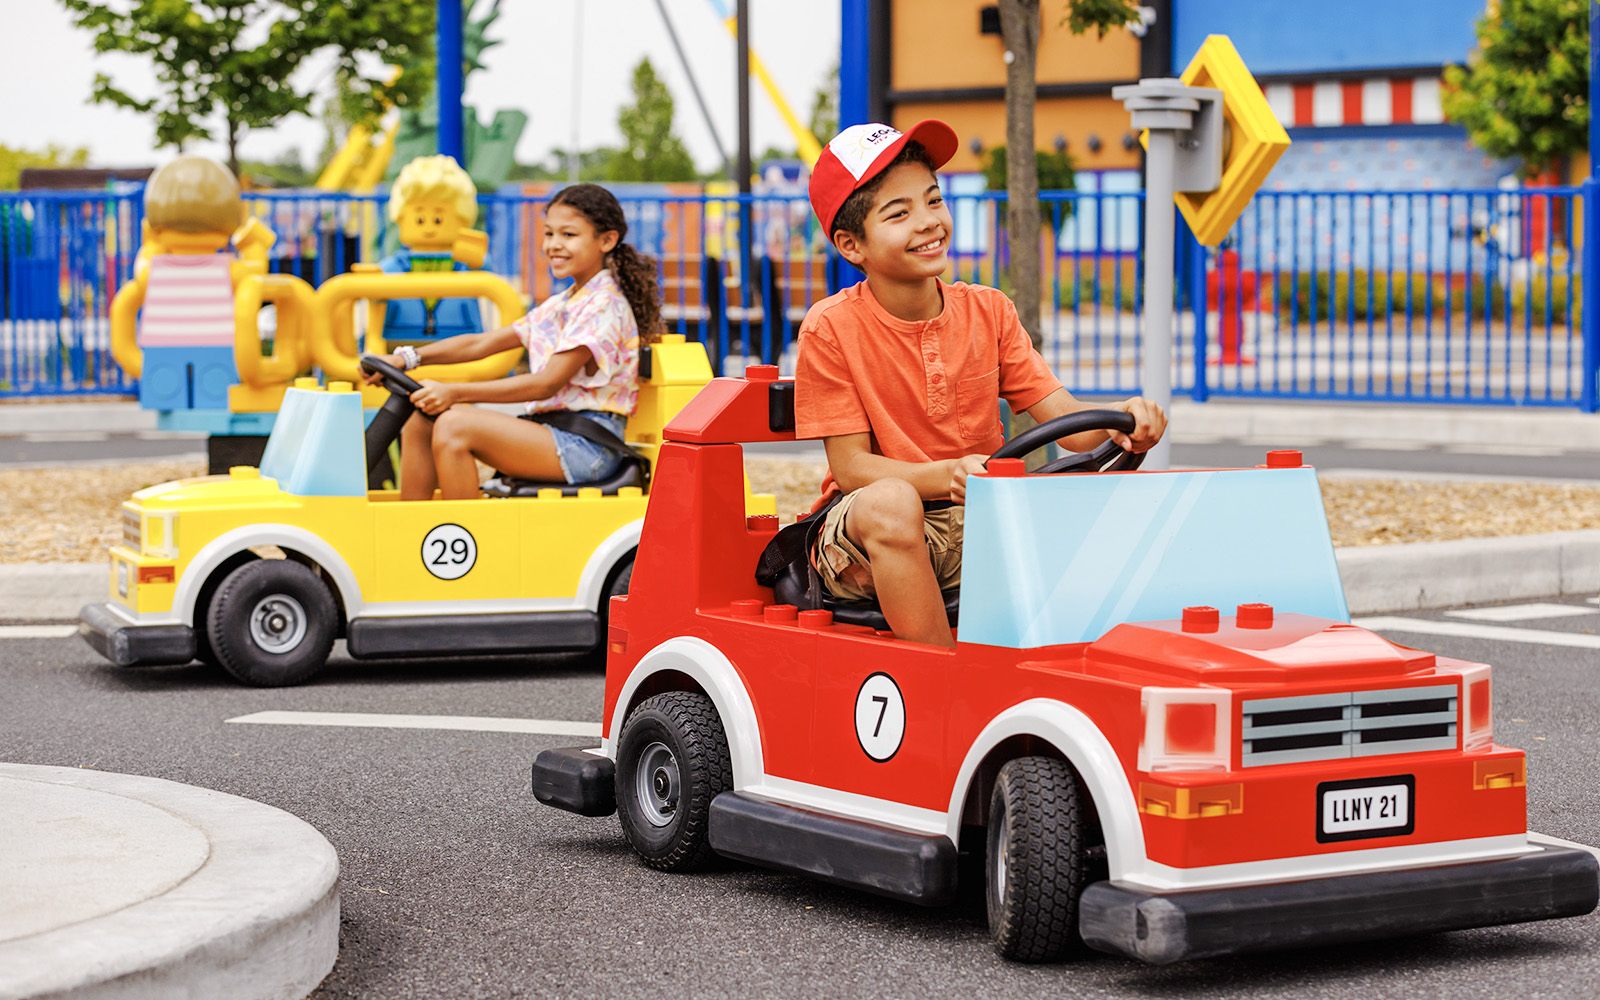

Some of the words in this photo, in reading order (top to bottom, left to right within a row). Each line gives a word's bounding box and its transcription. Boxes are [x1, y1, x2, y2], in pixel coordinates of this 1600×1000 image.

[431, 538, 468, 564] 29
[872, 695, 888, 737] 7
[1333, 796, 1373, 822] LLNY
[1380, 794, 1397, 818] 21
